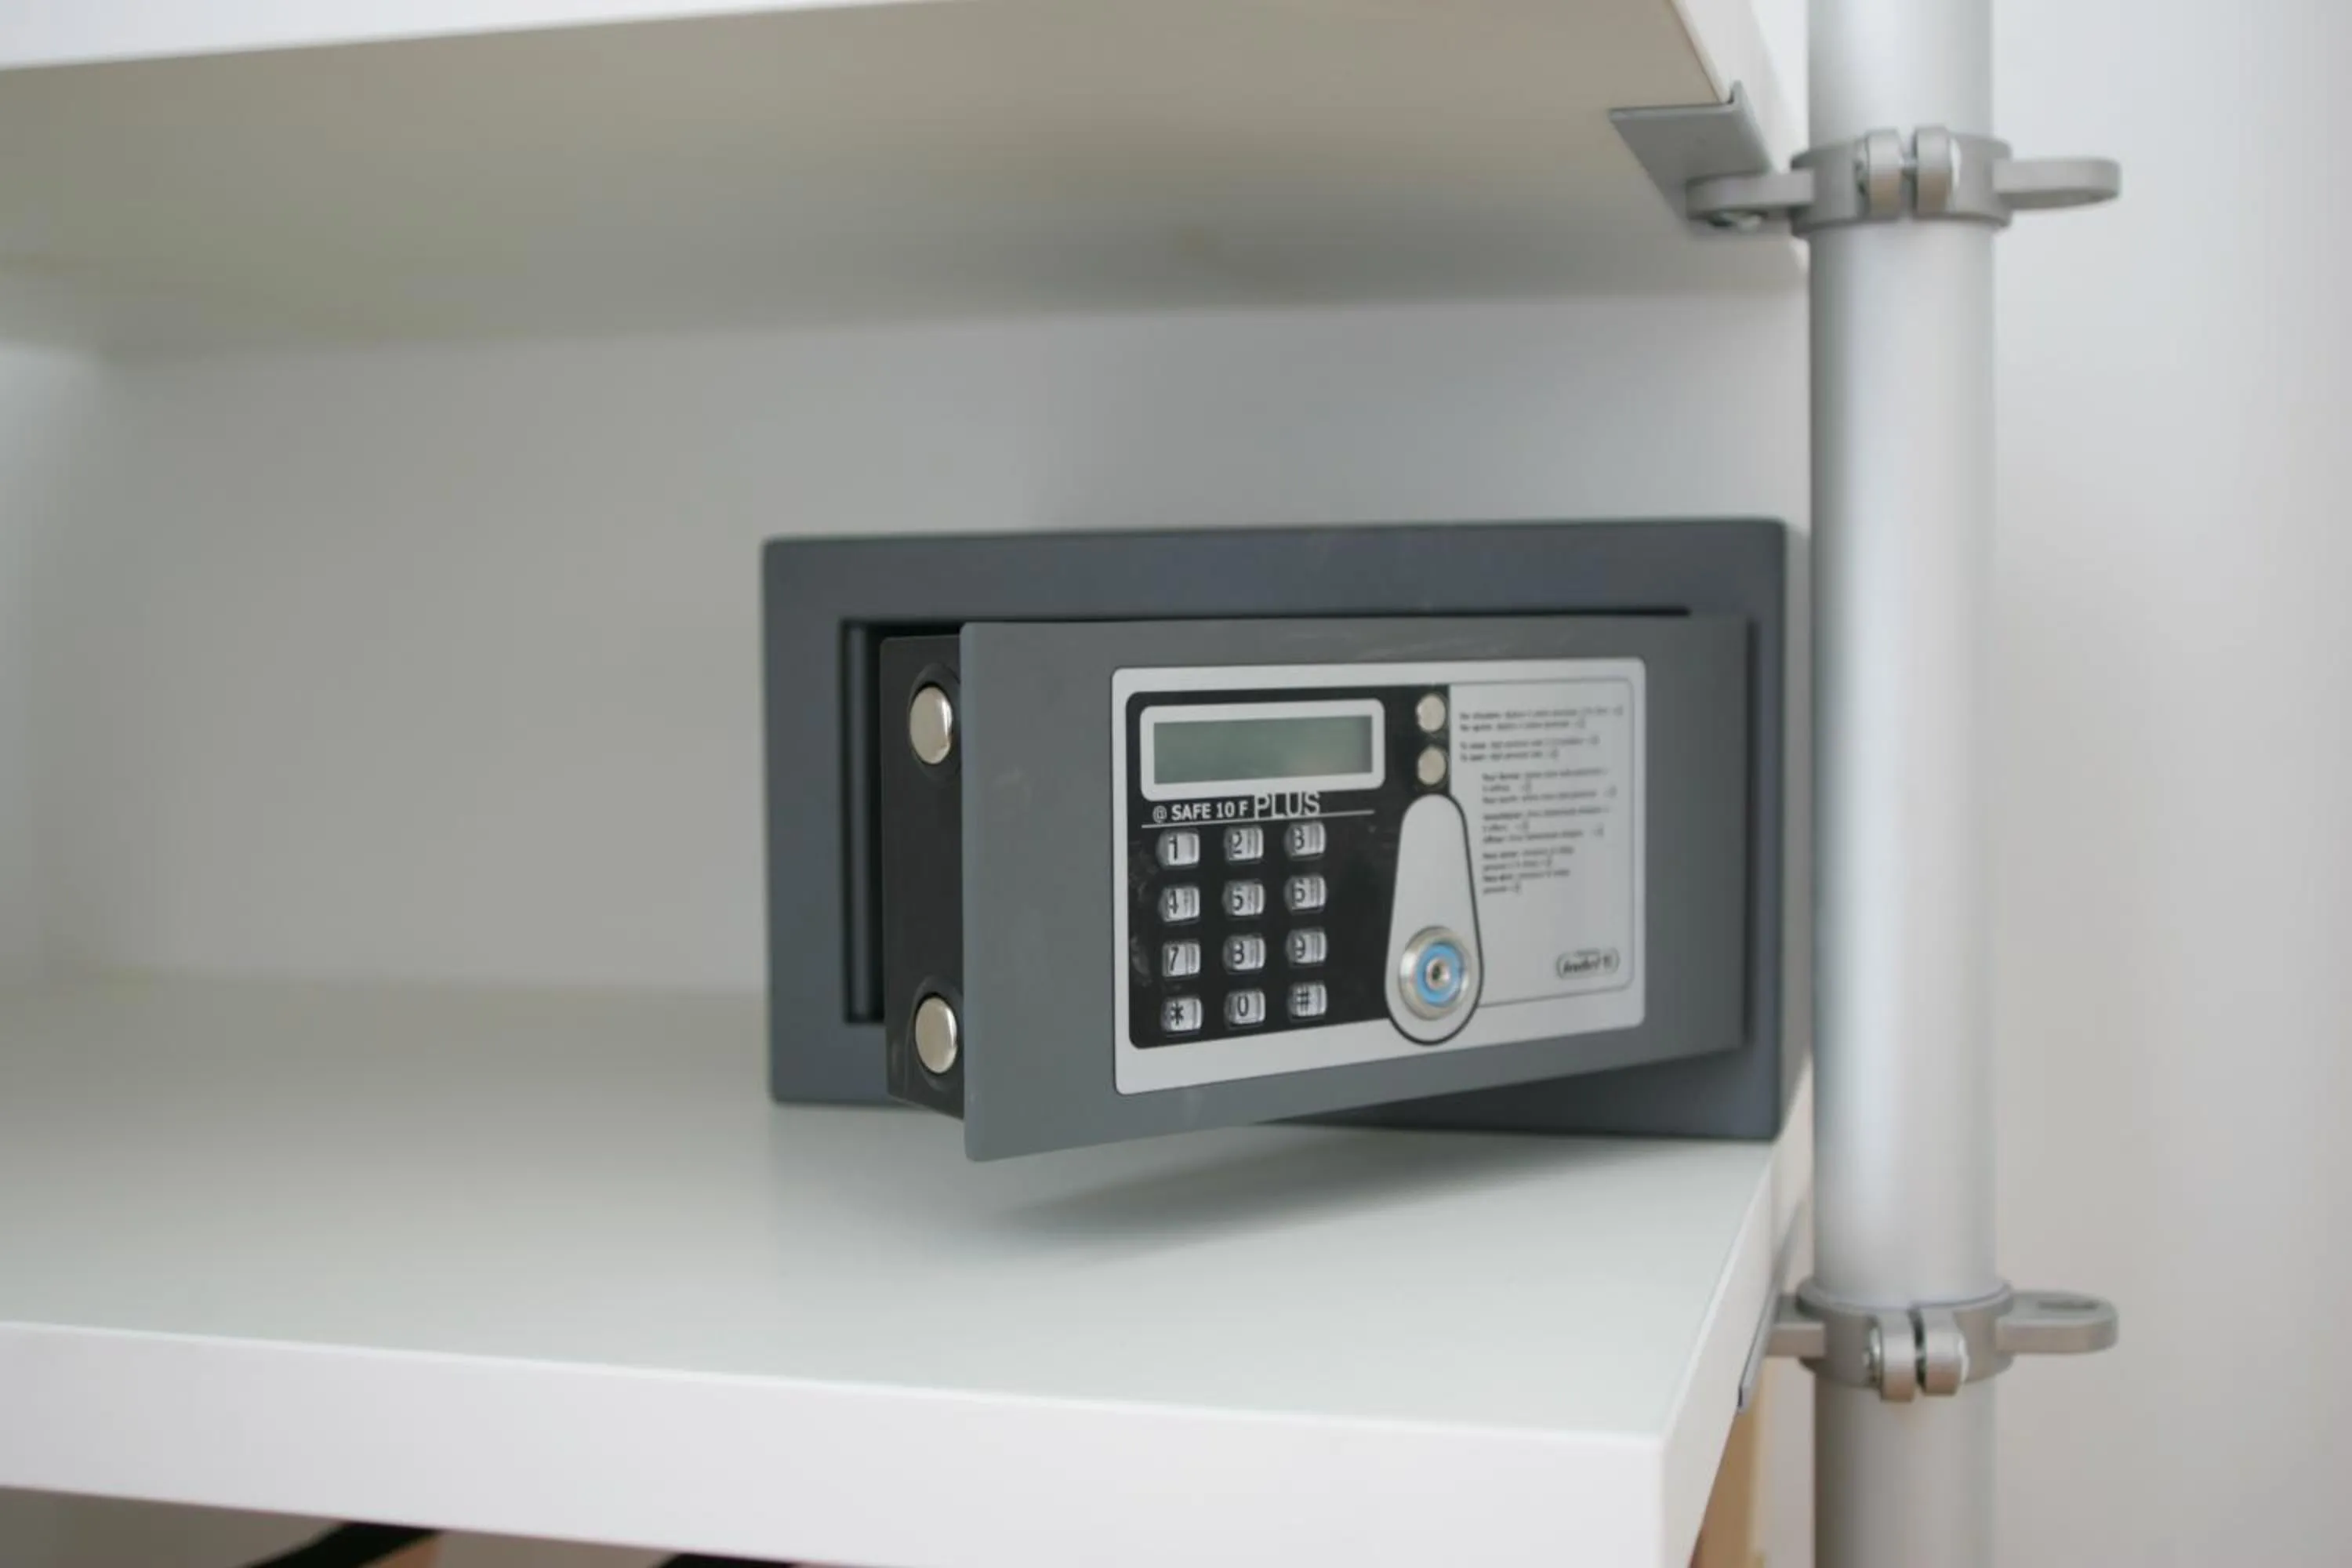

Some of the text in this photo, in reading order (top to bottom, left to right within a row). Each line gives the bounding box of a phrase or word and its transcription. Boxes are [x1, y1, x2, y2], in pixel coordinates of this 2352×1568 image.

[1171, 803, 1211, 821] SAFE
[1217, 801, 1235, 818] 10
[1239, 800, 1249, 817] F
[1254, 790, 1320, 819] PLUS
[1168, 834, 1178, 861] 1
[1232, 831, 1243, 855] 2
[1292, 827, 1305, 851] 3
[1167, 889, 1179, 915] 4
[1232, 886, 1243, 911] 5
[1292, 878, 1305, 902] 6
[1167, 946, 1179, 971] 7
[1232, 941, 1245, 965] 8
[1294, 935, 1306, 959] 9
[1236, 993, 1250, 1018] 0
